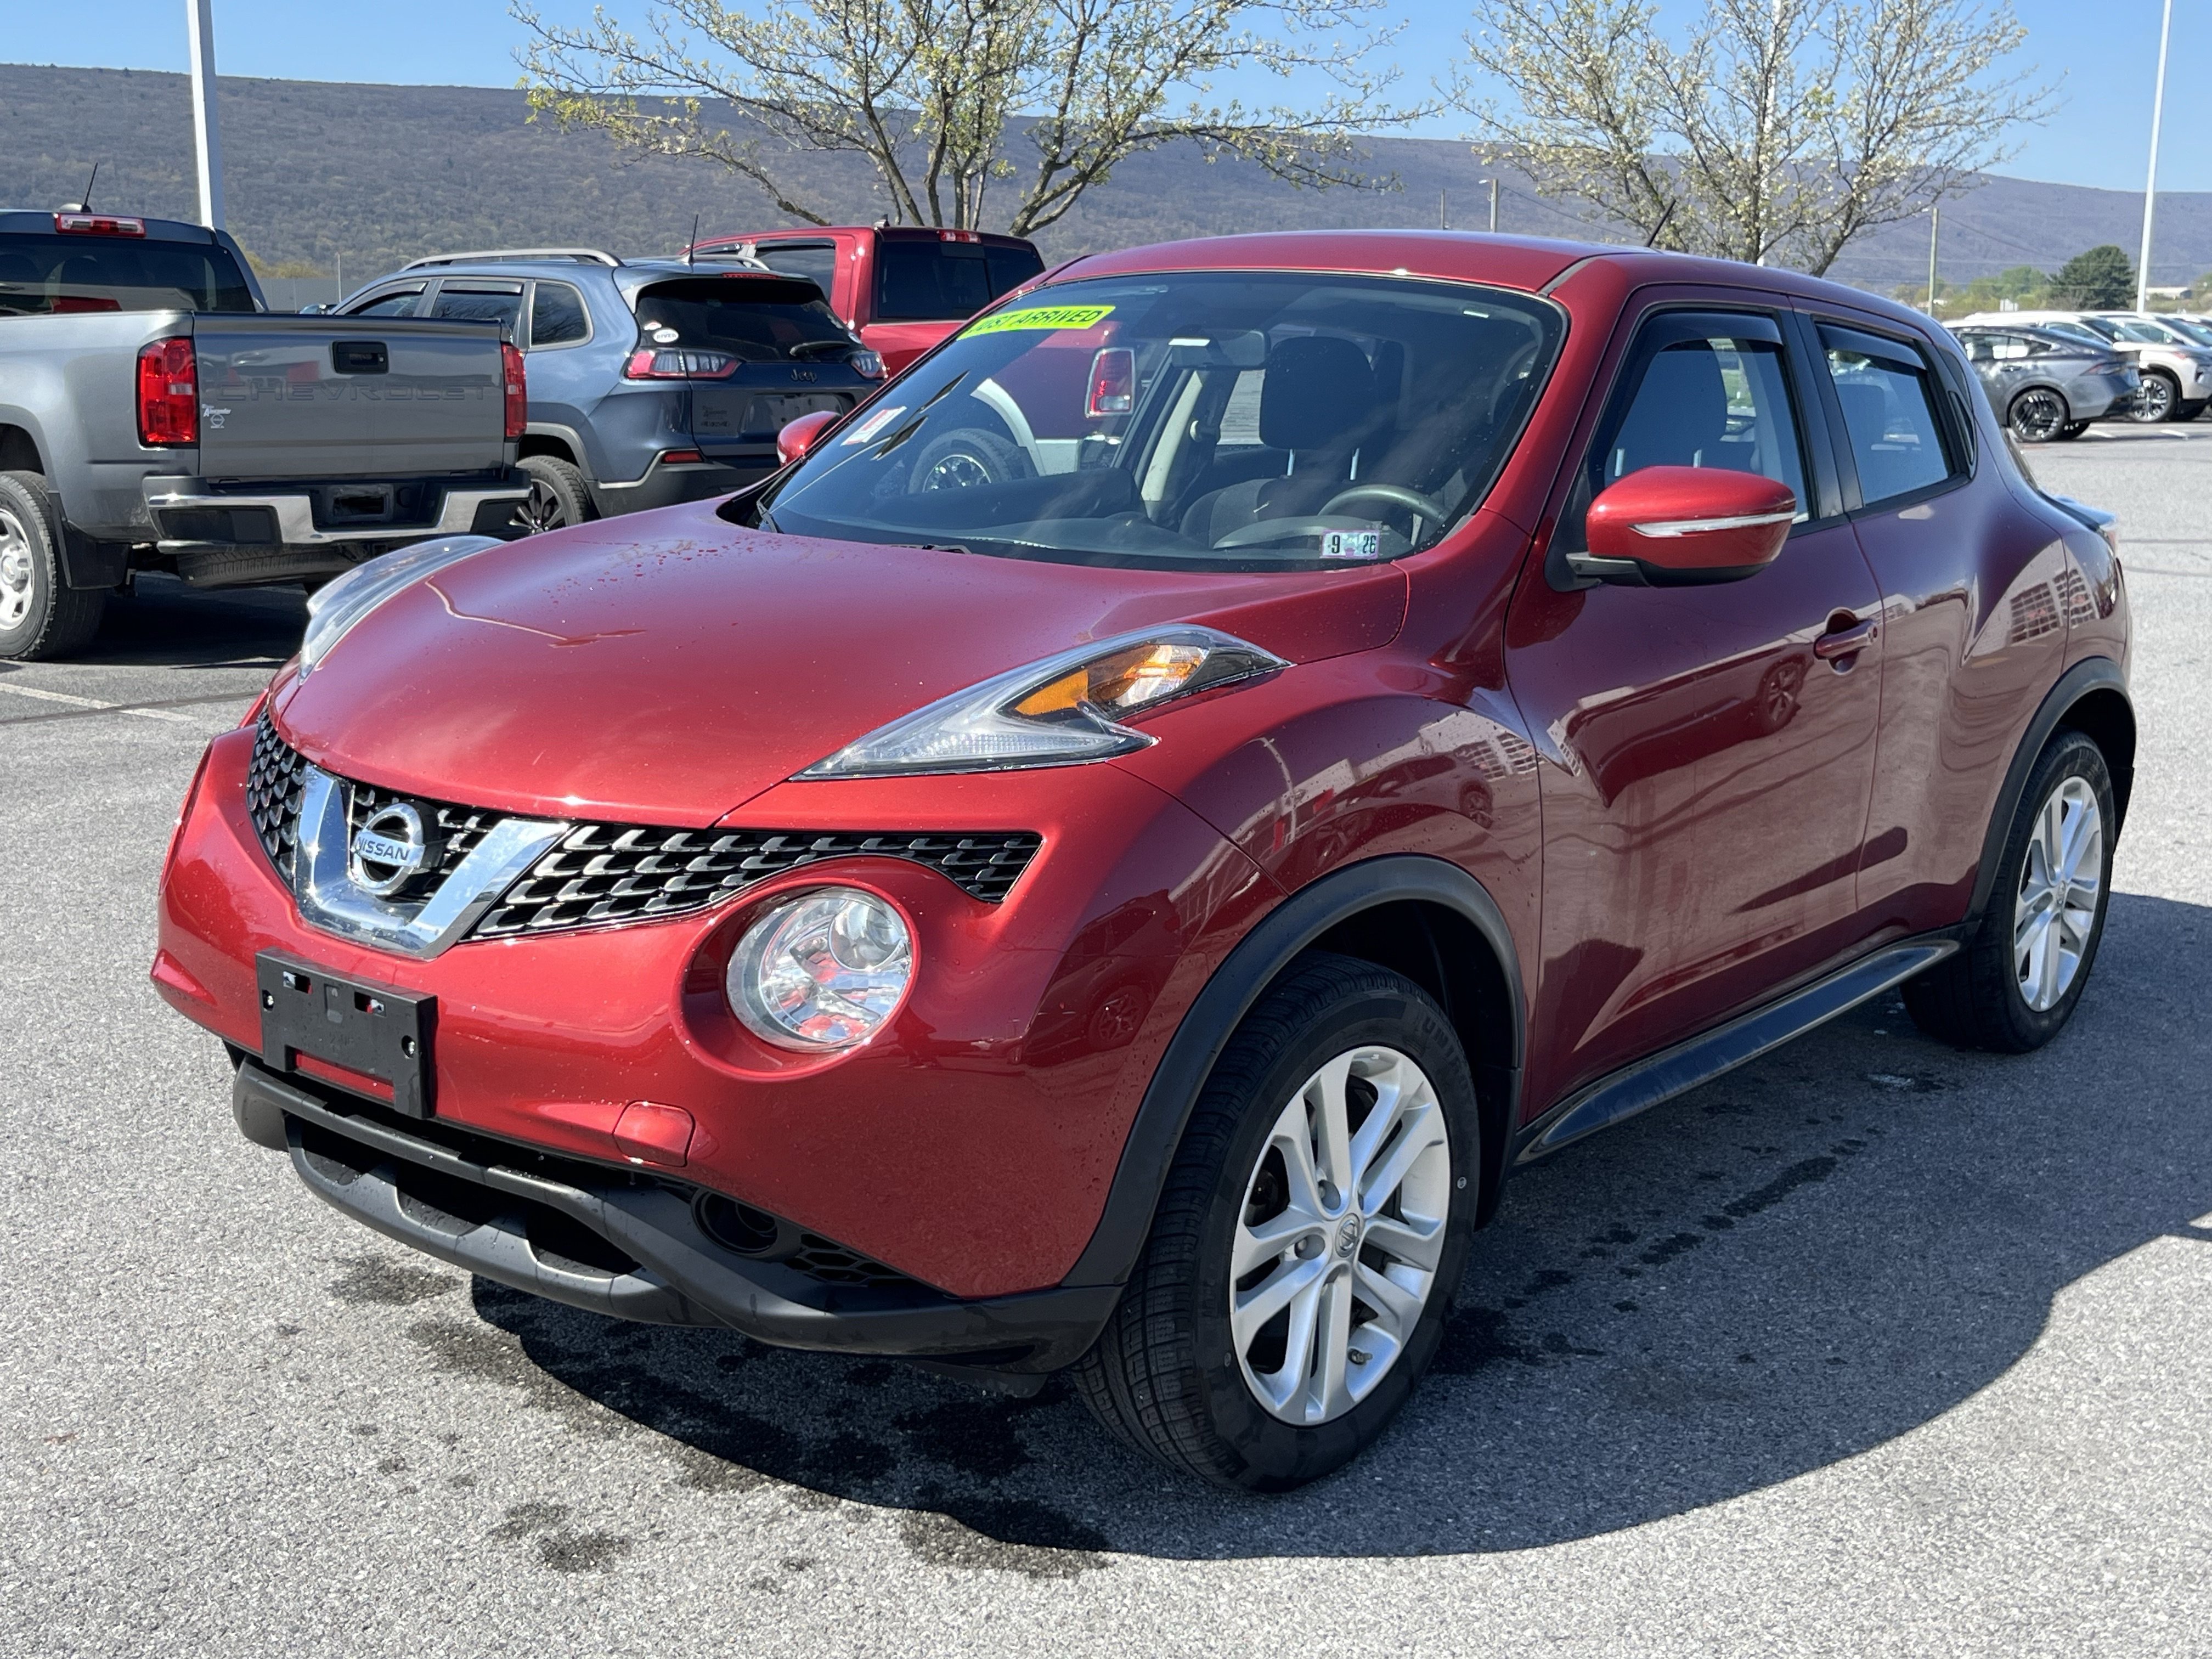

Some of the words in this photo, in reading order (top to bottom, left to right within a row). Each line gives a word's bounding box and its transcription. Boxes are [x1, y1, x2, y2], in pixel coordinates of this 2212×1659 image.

[1013, 310, 1104, 325] ARRIVED
[791, 369, 817, 383] Jeep
[217, 383, 486, 402] CHEVROLET
[1331, 535, 1340, 554] 9
[1362, 535, 1376, 554] 26
[356, 837, 410, 861] NISSAN
